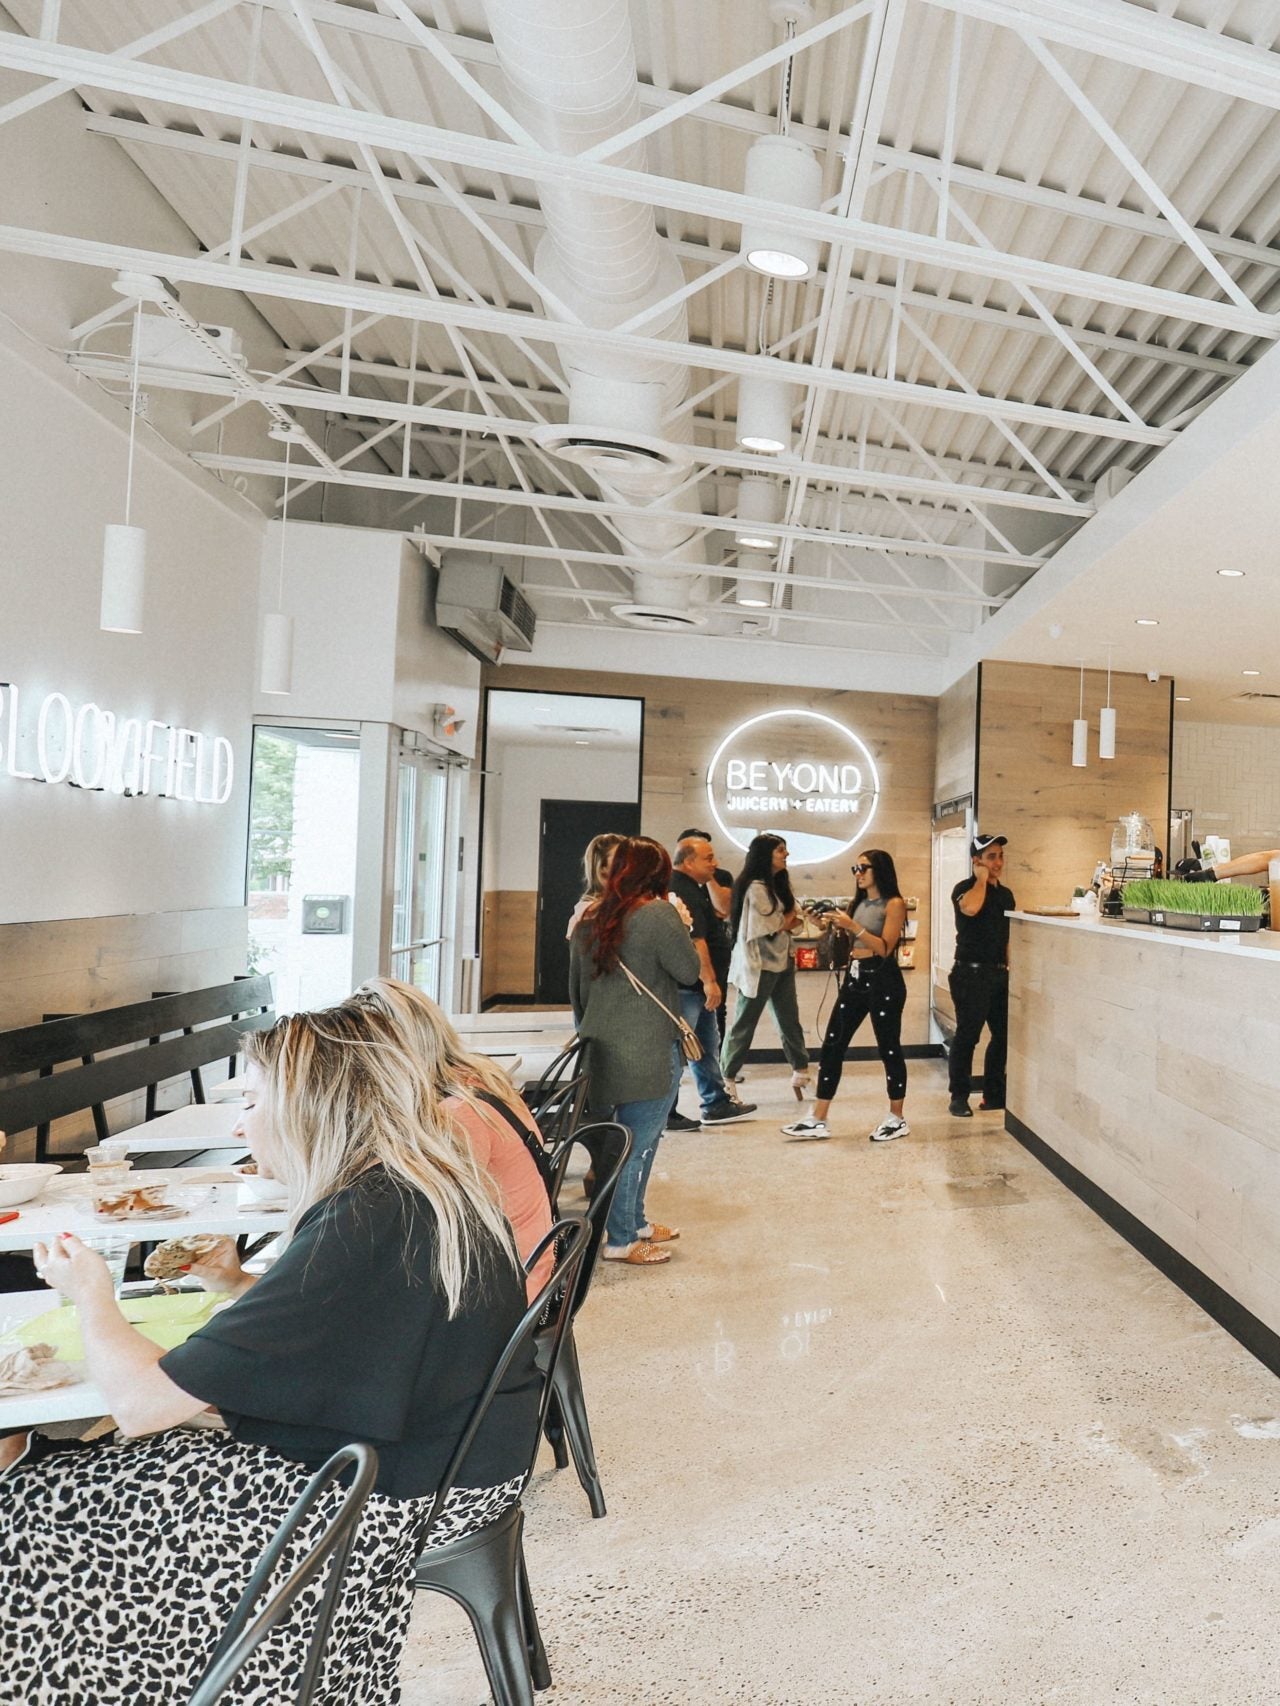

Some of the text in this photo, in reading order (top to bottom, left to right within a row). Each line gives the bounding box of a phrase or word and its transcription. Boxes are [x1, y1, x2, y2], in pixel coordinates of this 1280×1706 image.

[0, 682, 235, 805] LOOMFIELD
[726, 759, 863, 795] BEYOND
[727, 795, 788, 812] JUICERY
[806, 798, 859, 814] EATERY
